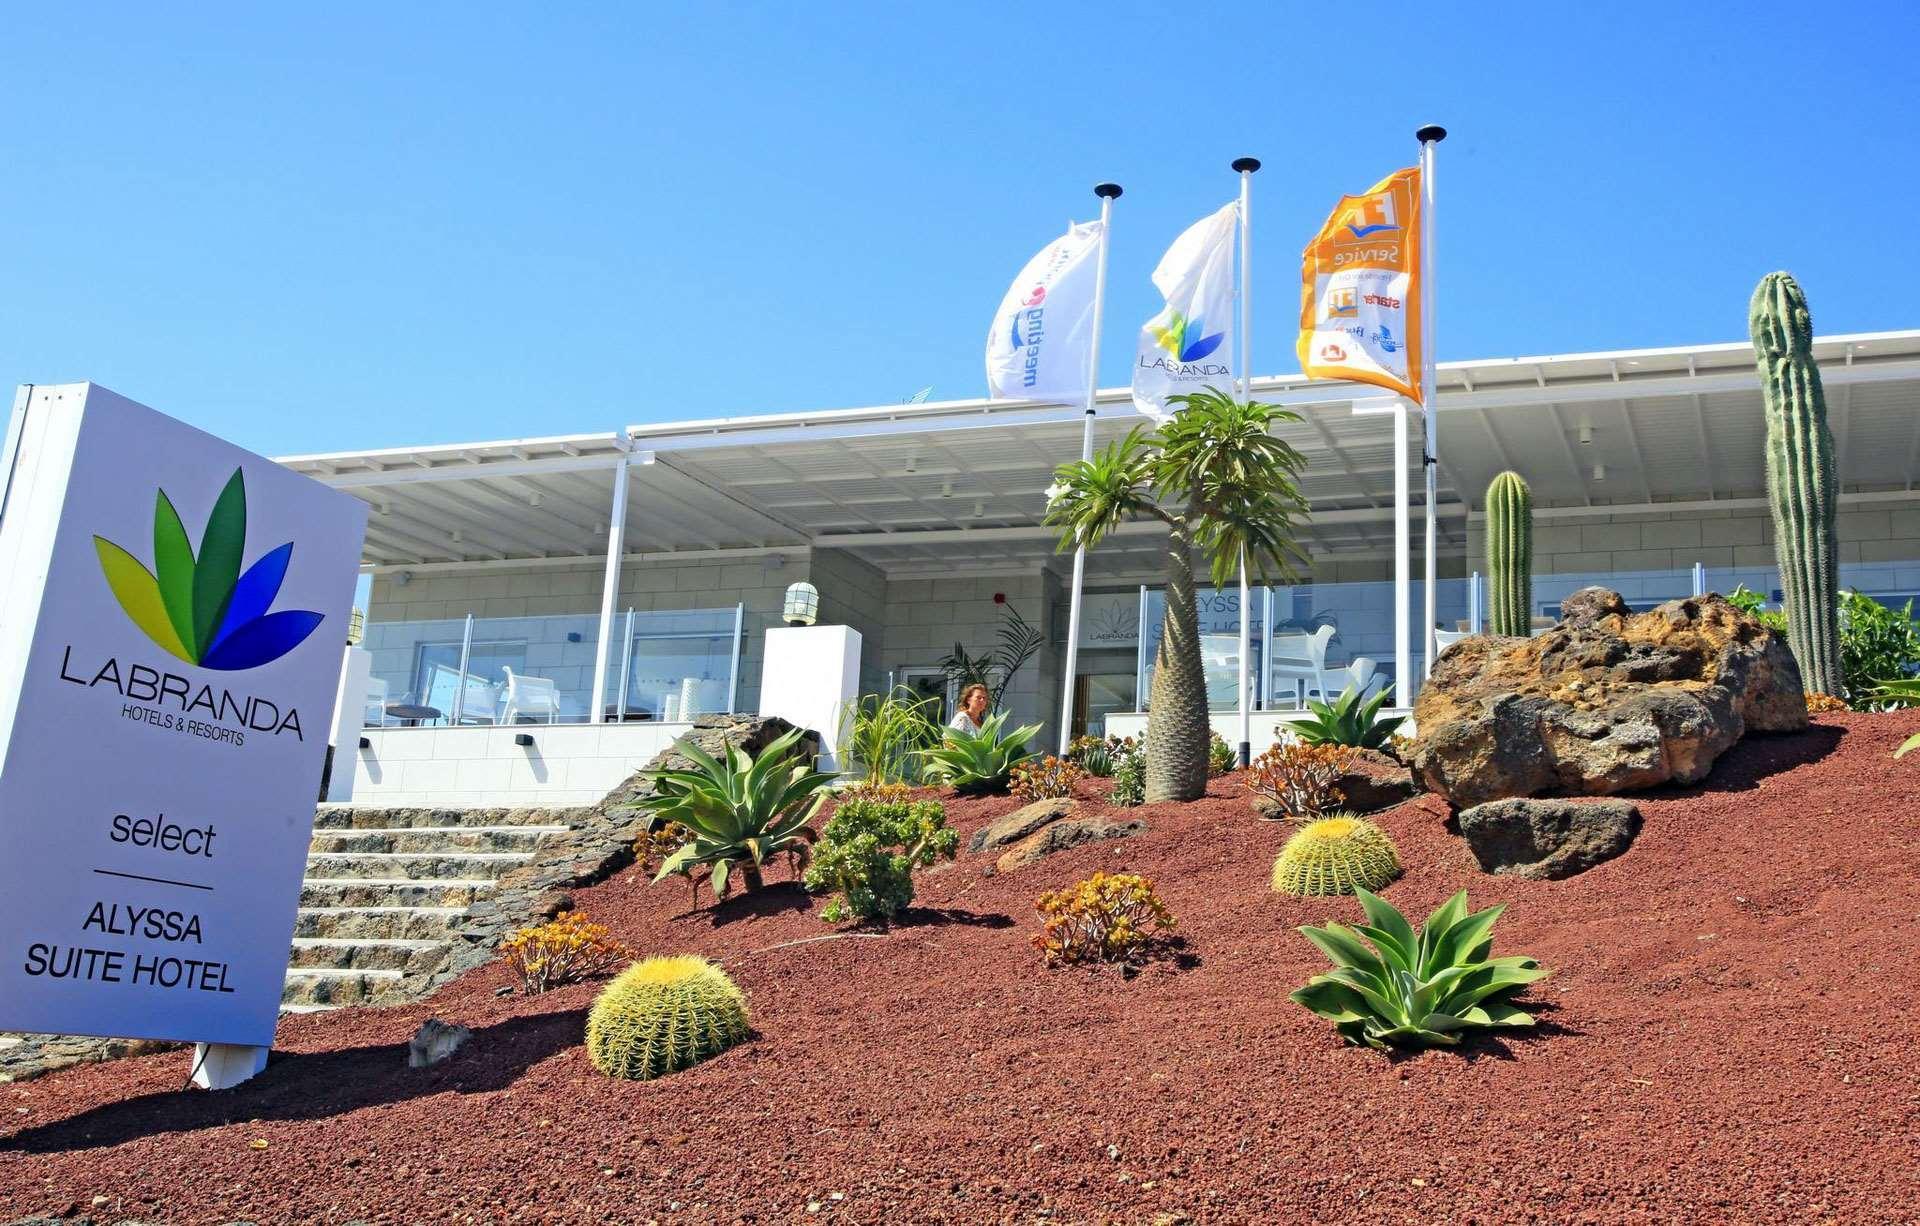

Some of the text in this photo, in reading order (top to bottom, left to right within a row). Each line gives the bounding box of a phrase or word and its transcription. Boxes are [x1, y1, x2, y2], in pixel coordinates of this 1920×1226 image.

[60, 645, 304, 742] LABRANDA
[121, 703, 245, 746] HOTELS & RESORTS
[110, 813, 217, 858] select
[82, 901, 202, 944] ALYSSA
[24, 943, 235, 993] SUITE HOTEL
